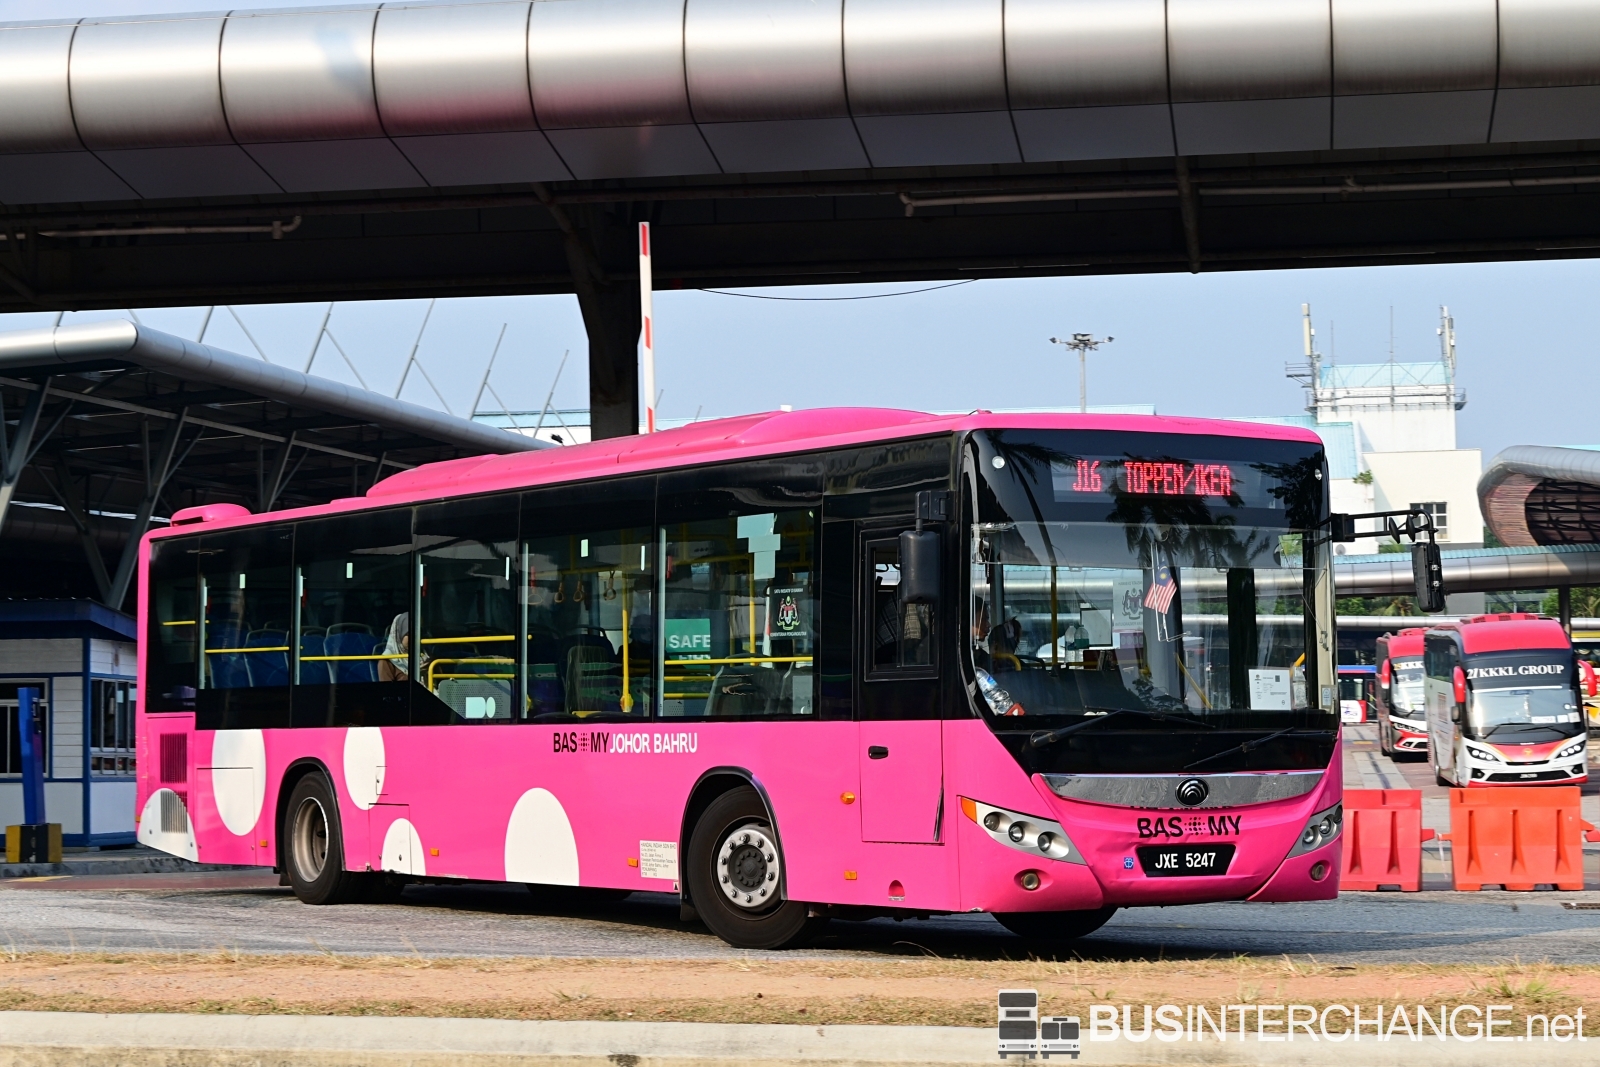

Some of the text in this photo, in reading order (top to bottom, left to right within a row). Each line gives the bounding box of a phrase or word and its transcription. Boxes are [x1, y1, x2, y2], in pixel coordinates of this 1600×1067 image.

[1072, 460, 1231, 496] J16 TOPPEN/IKEA
[669, 634, 711, 649] SAFE
[1401, 661, 1425, 670] KKK
[1518, 664, 1565, 675] GROUP
[553, 732, 698, 754] BAS MY JOHOR BAHRU
[1137, 815, 1242, 838] BAS MY
[1154, 852, 1217, 869] JXE 5247
